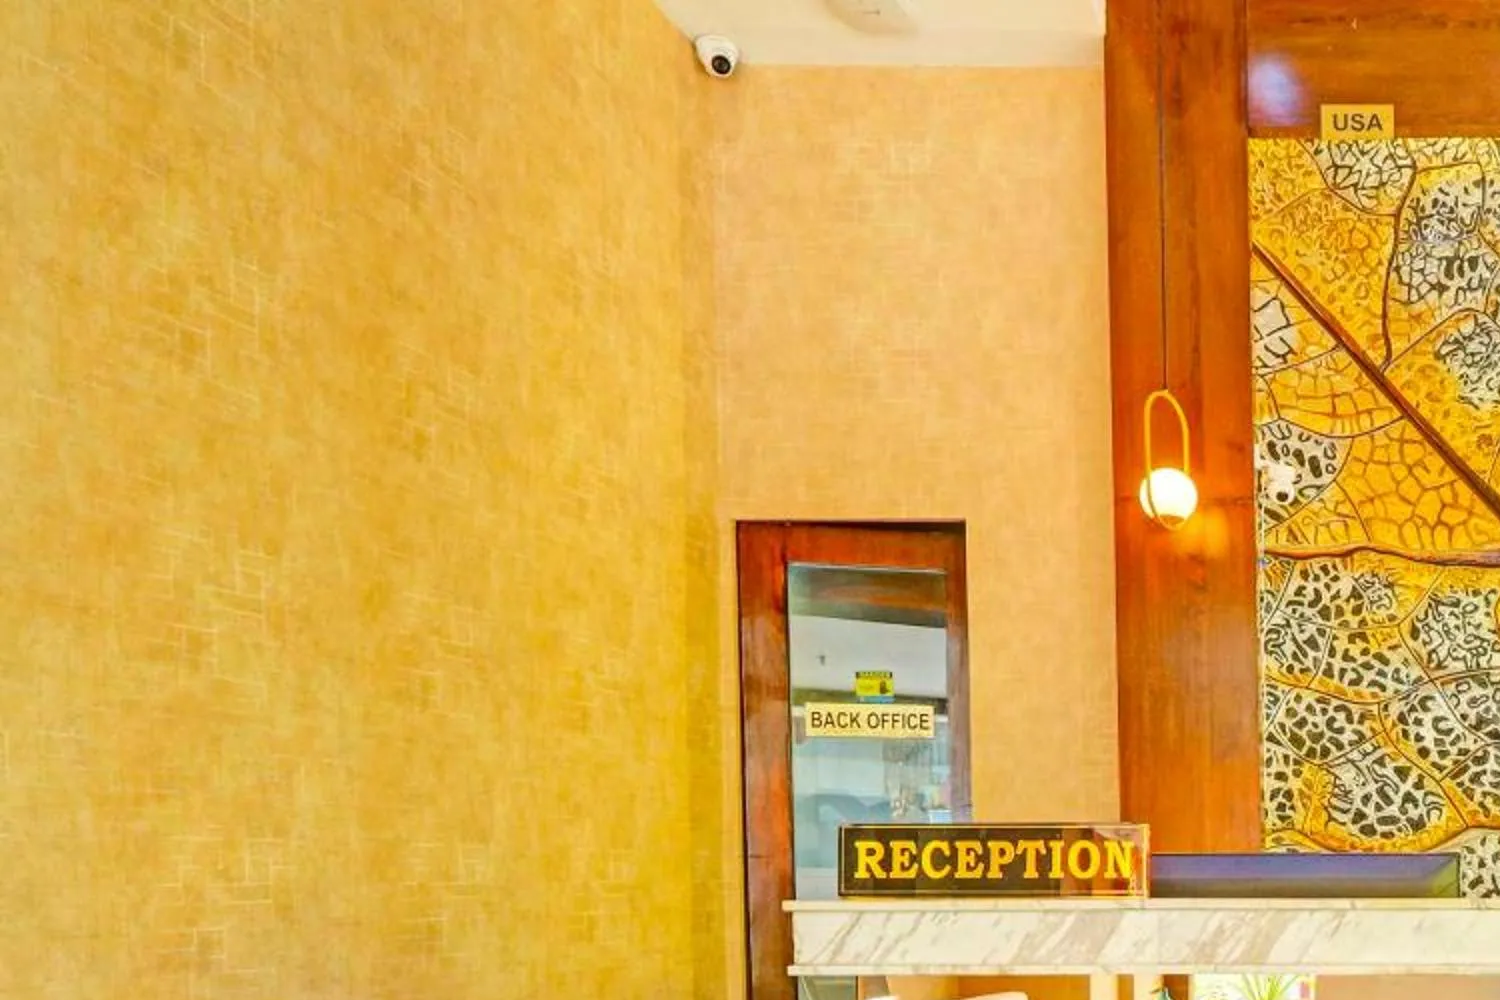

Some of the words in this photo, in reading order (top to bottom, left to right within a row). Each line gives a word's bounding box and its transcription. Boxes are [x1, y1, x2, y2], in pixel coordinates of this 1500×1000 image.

[1332, 113, 1383, 132] USA
[810, 711, 861, 729] BACK
[866, 711, 930, 731] OFFICE
[853, 839, 1136, 880] RECEPTION
